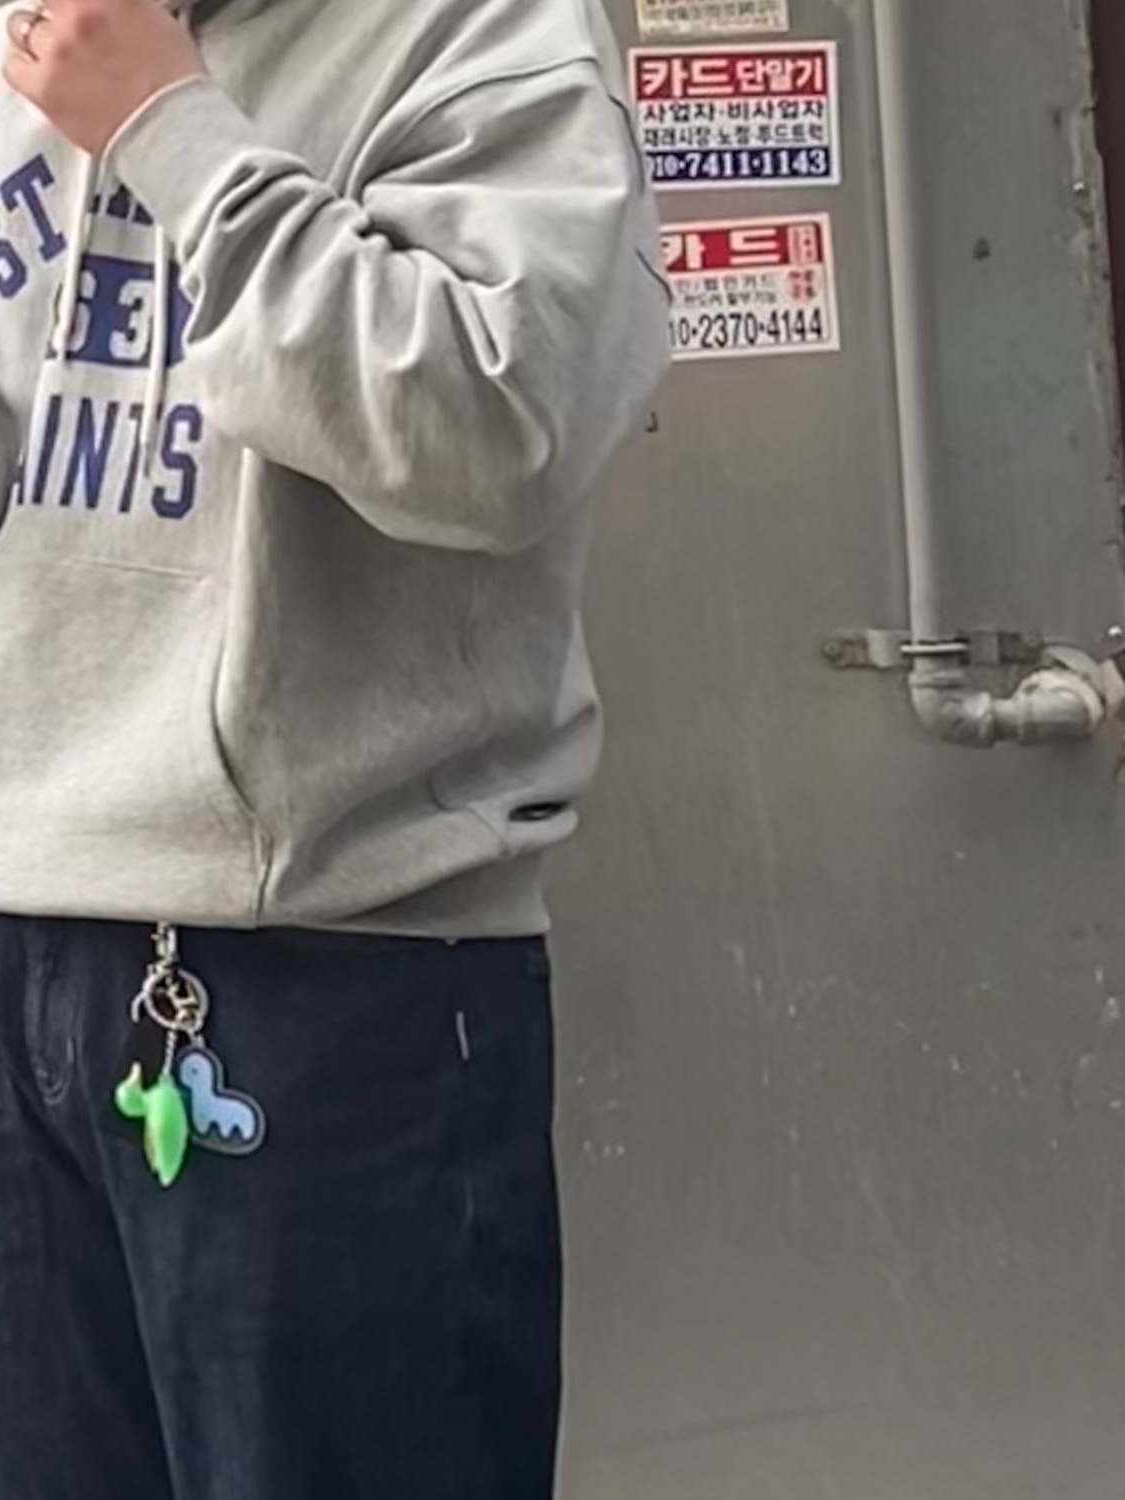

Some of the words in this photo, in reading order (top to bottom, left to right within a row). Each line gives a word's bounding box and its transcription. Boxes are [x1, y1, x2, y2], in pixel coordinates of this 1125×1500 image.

[641, 56, 823, 96] 카드단말기
[661, 228, 780, 270] 카드
[15, 395, 203, 519] INTS
